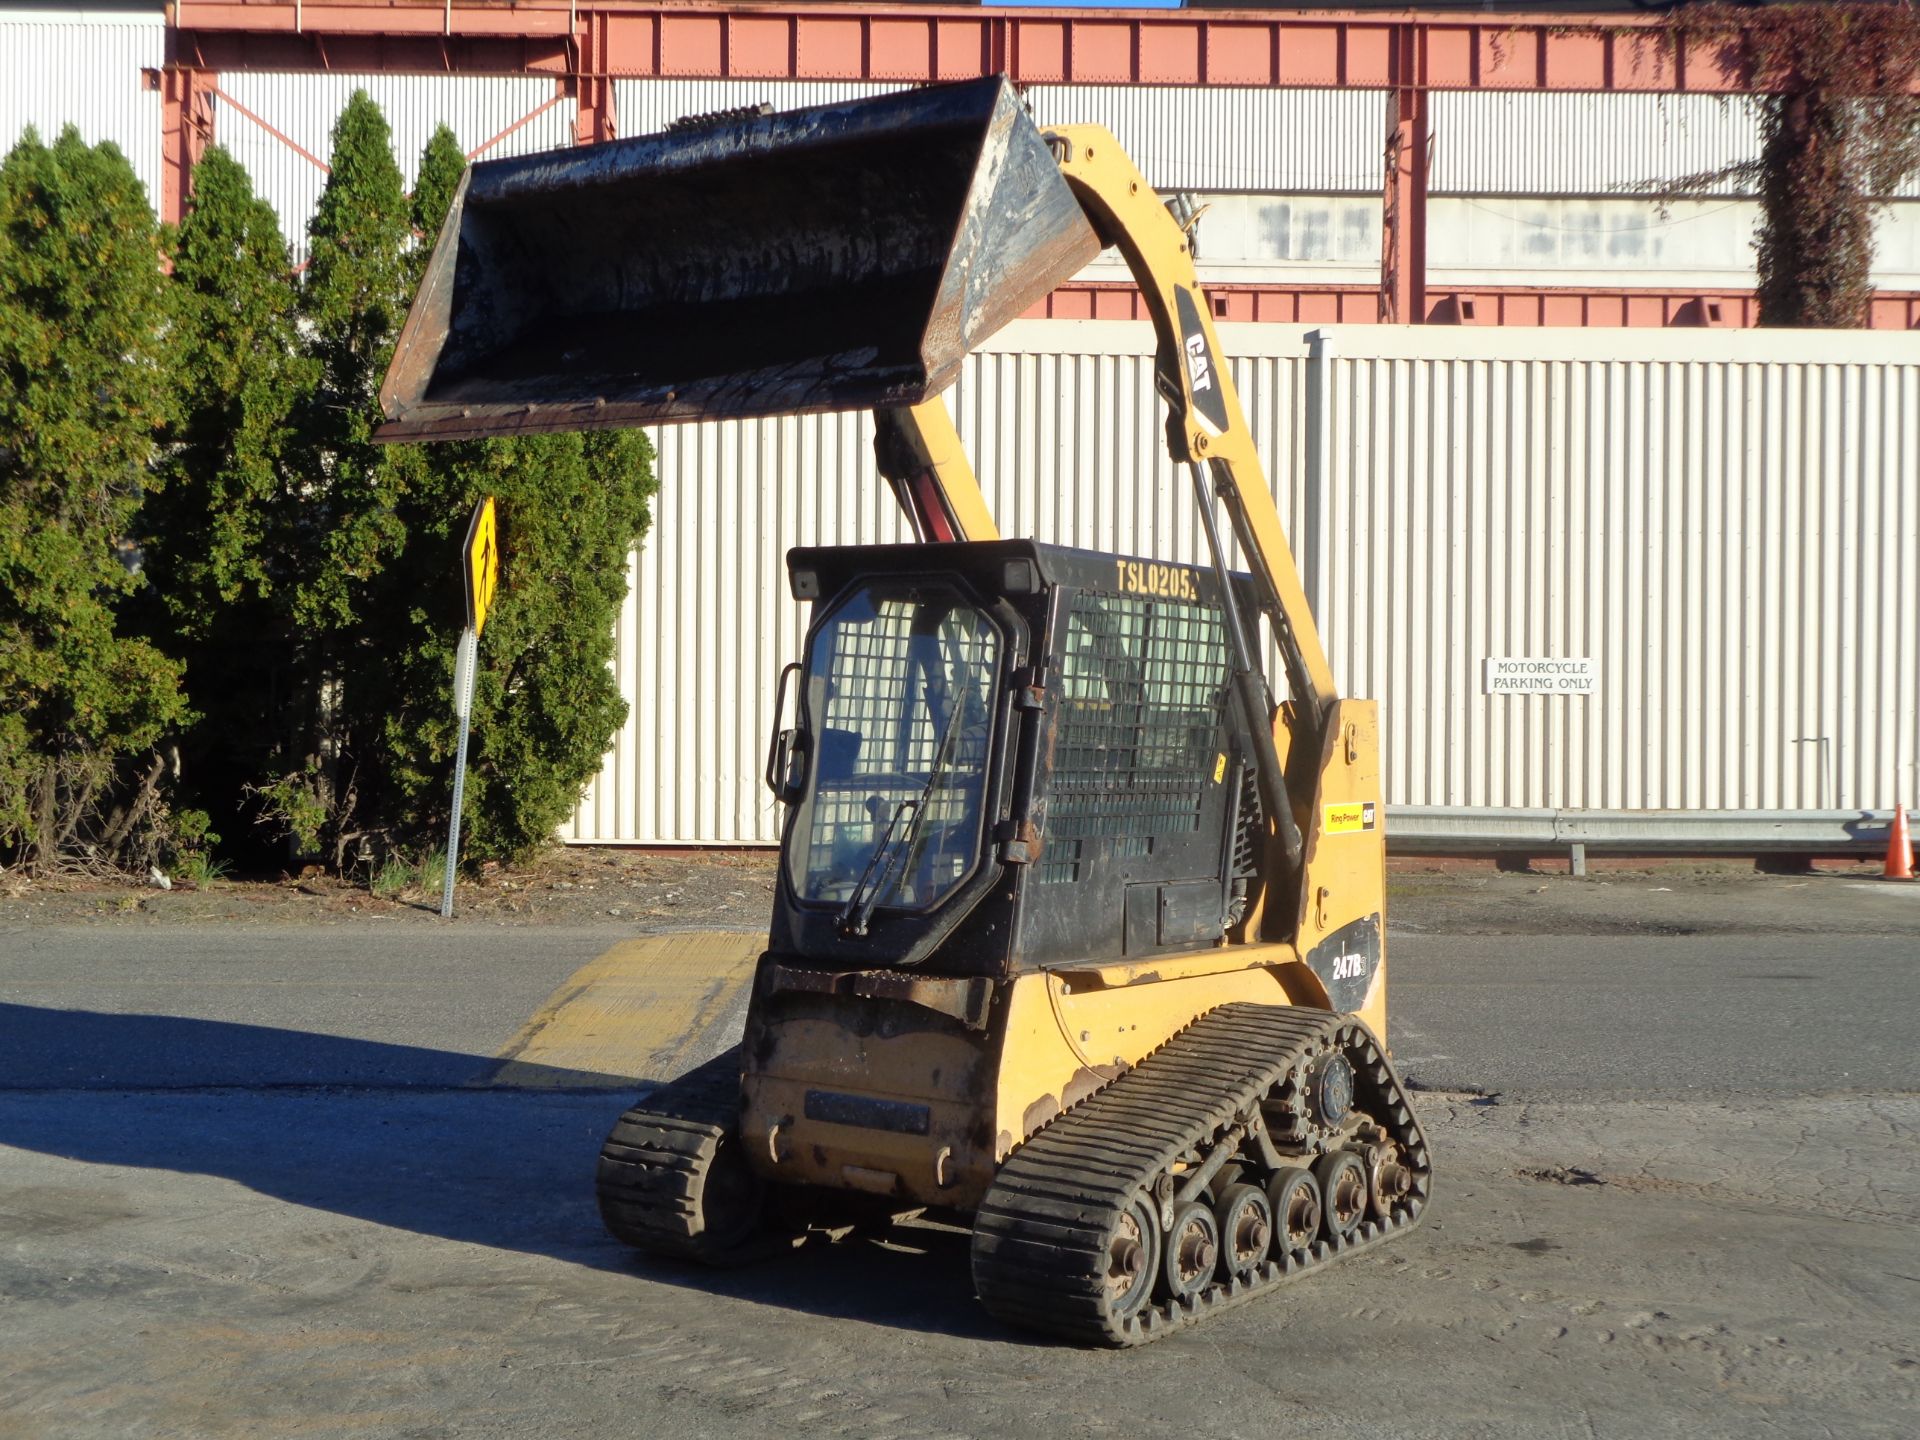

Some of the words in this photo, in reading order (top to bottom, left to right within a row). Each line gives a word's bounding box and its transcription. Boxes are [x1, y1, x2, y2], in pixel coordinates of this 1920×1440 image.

[1186, 333, 1211, 392] CAT
[1498, 662, 1588, 673] MOTORCYCLE
[1494, 678, 1553, 689] PARKING
[1559, 678, 1593, 689] ONLY
[1331, 814, 1342, 824] Ring
[1343, 813, 1359, 822] Power
[1333, 953, 1361, 980] 247B
